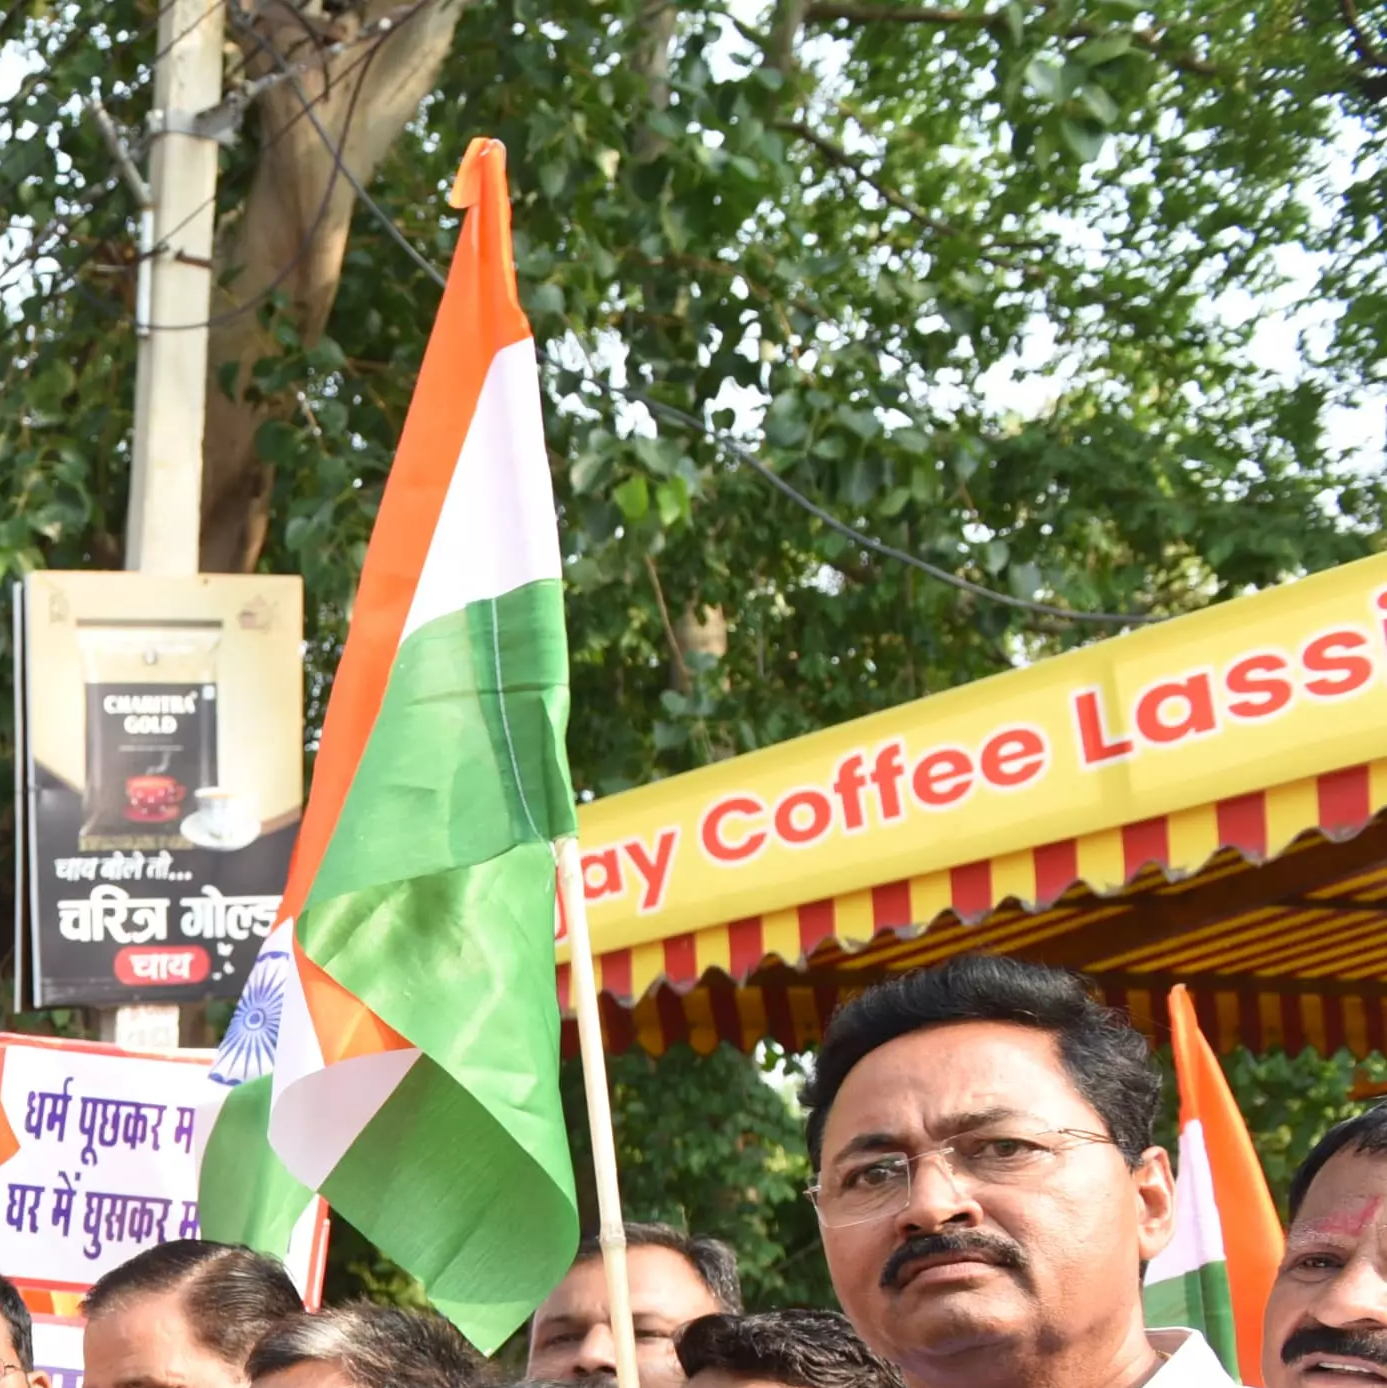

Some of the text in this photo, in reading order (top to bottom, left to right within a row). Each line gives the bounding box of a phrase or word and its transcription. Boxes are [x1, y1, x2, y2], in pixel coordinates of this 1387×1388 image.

[123, 714, 178, 734] GOLD
[555, 831, 675, 940] ay
[702, 728, 1045, 861] Coffee
[57, 884, 170, 943] चरित्र
[129, 953, 194, 980] चाय
[25, 1076, 74, 1142] धर्म
[79, 1096, 167, 1166] पूछकर
[6, 1183, 45, 1233] घर
[51, 1171, 81, 1237] में
[83, 1191, 173, 1260] घुसकर
